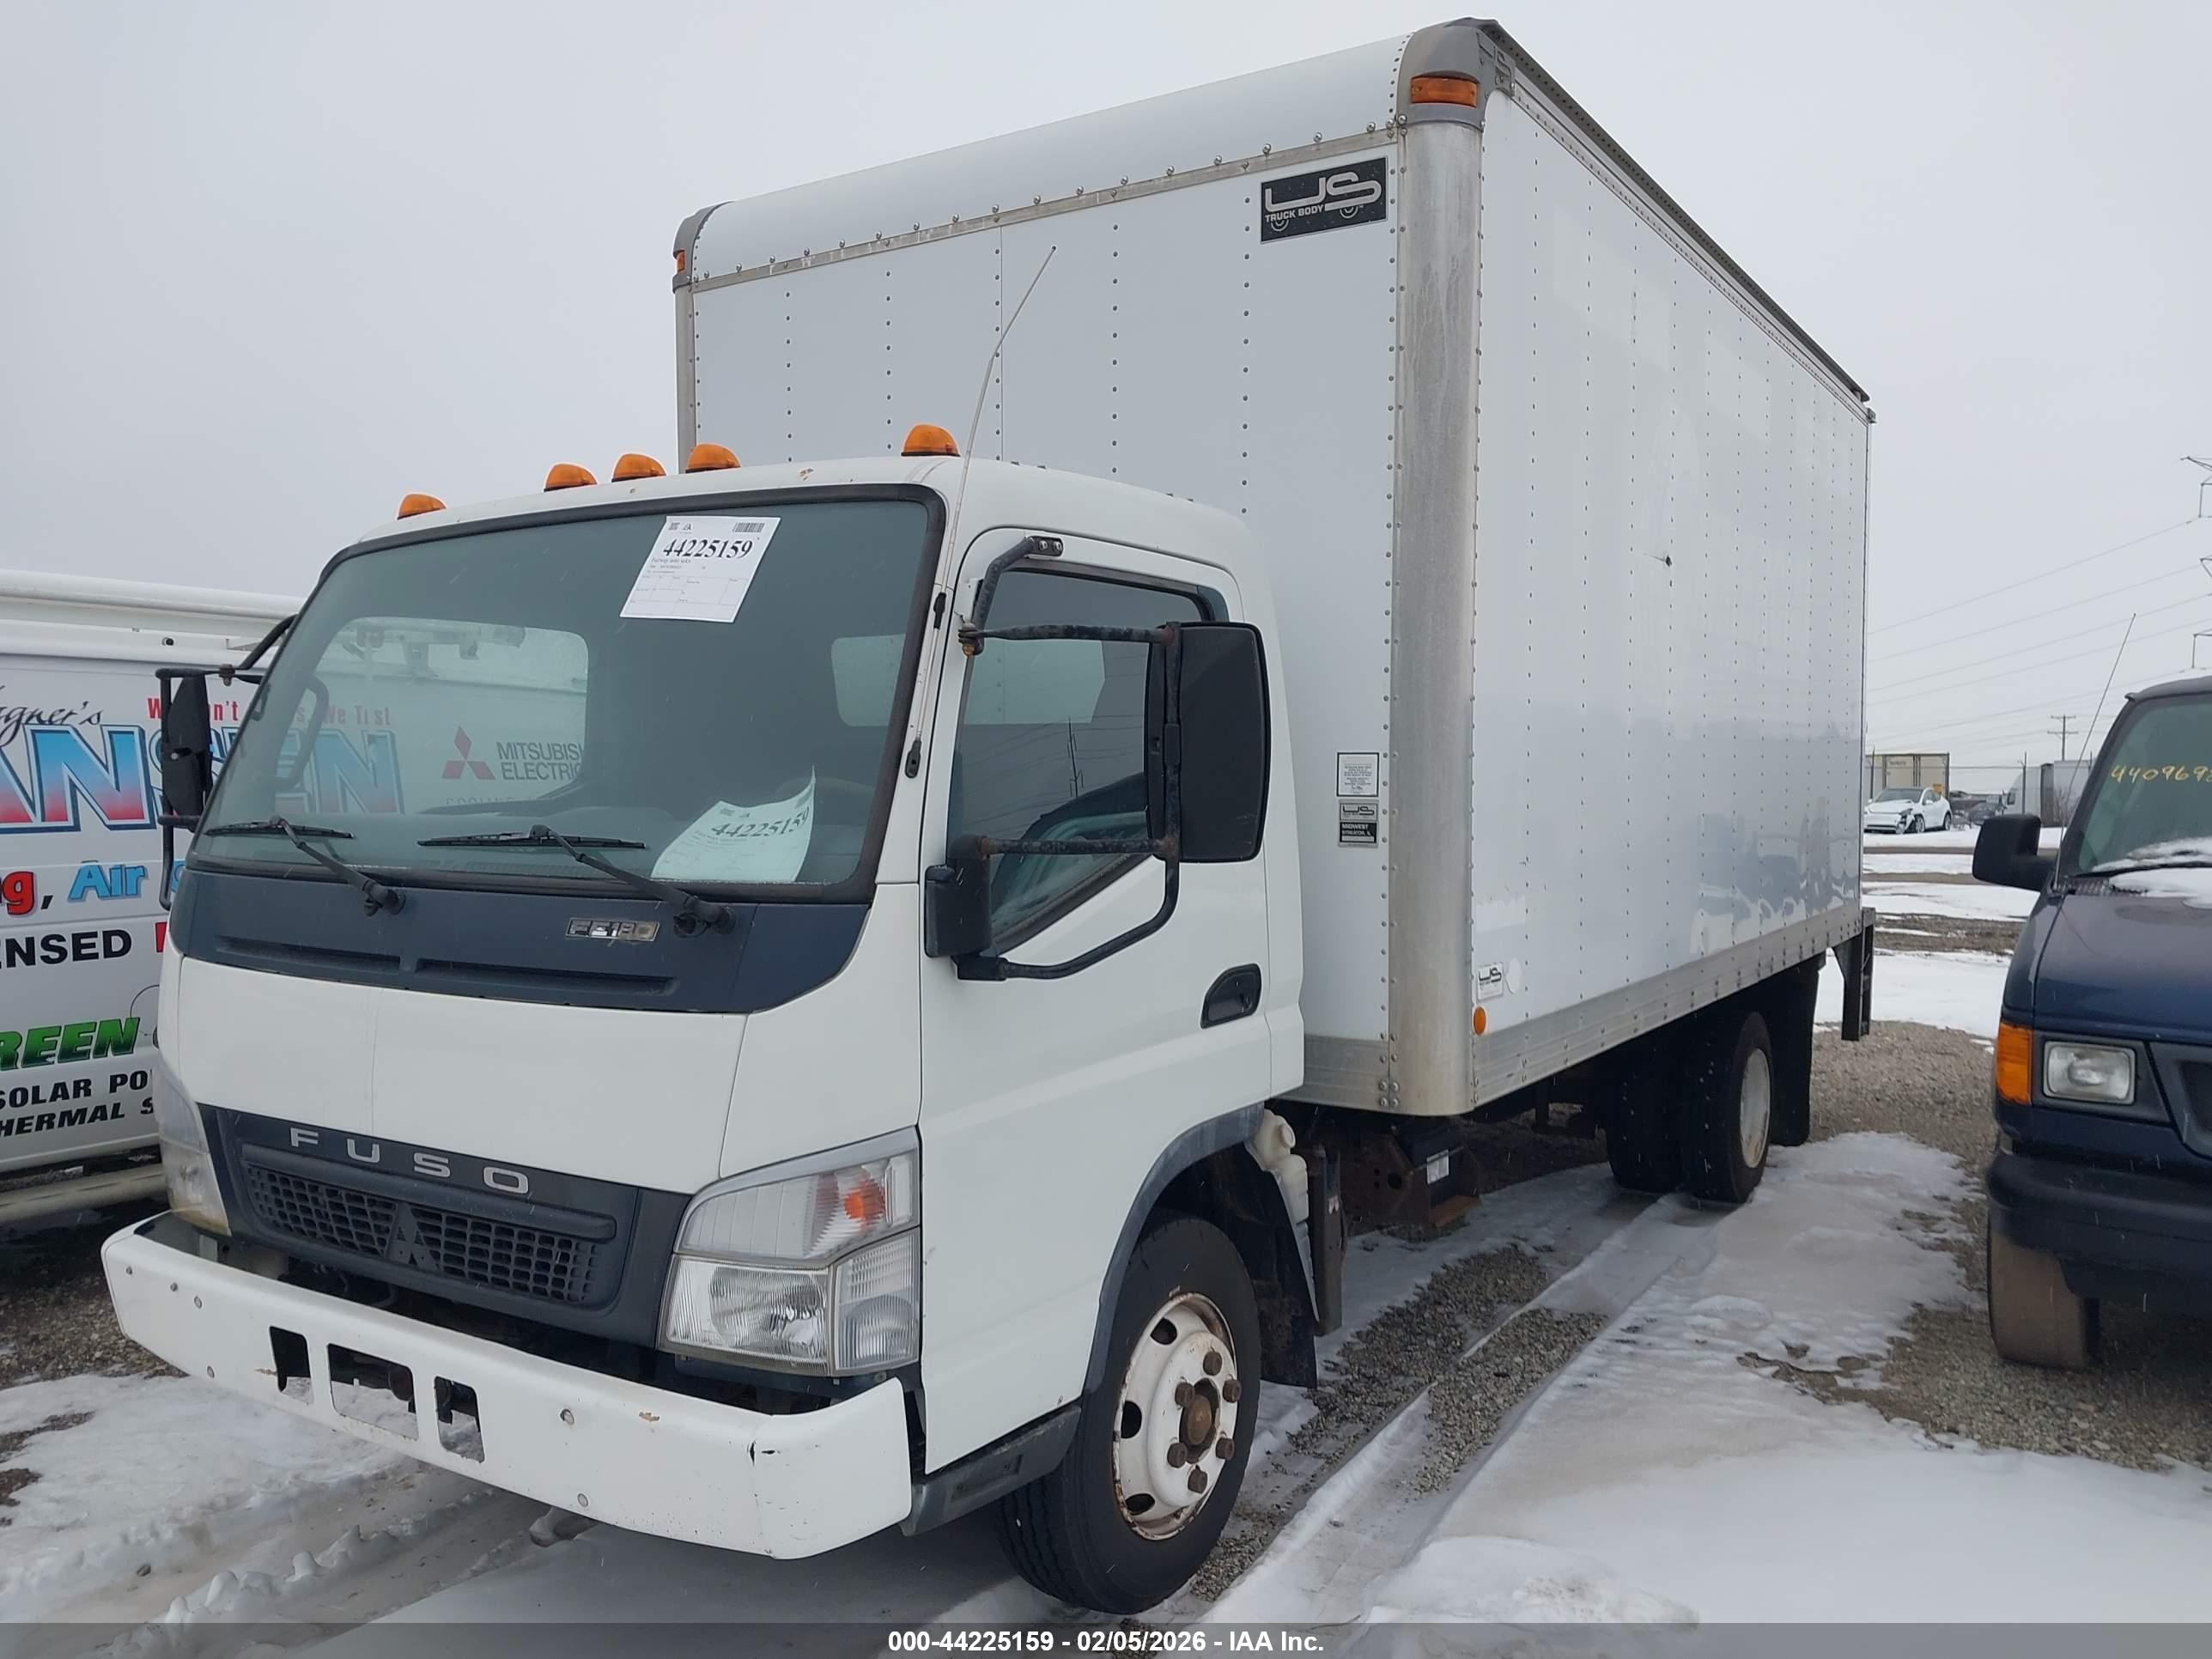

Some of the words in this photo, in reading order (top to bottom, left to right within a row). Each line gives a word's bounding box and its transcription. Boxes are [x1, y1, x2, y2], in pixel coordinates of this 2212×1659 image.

[1265, 171, 1382, 213] US
[1265, 210, 1296, 222] TRUCK
[1298, 204, 1323, 216] BODY
[663, 538, 754, 559] 44225159
[67, 864, 149, 902] Air
[0, 929, 131, 969] NSED
[109, 1068, 153, 1094] PO
[290, 1127, 529, 1194] FUSO
